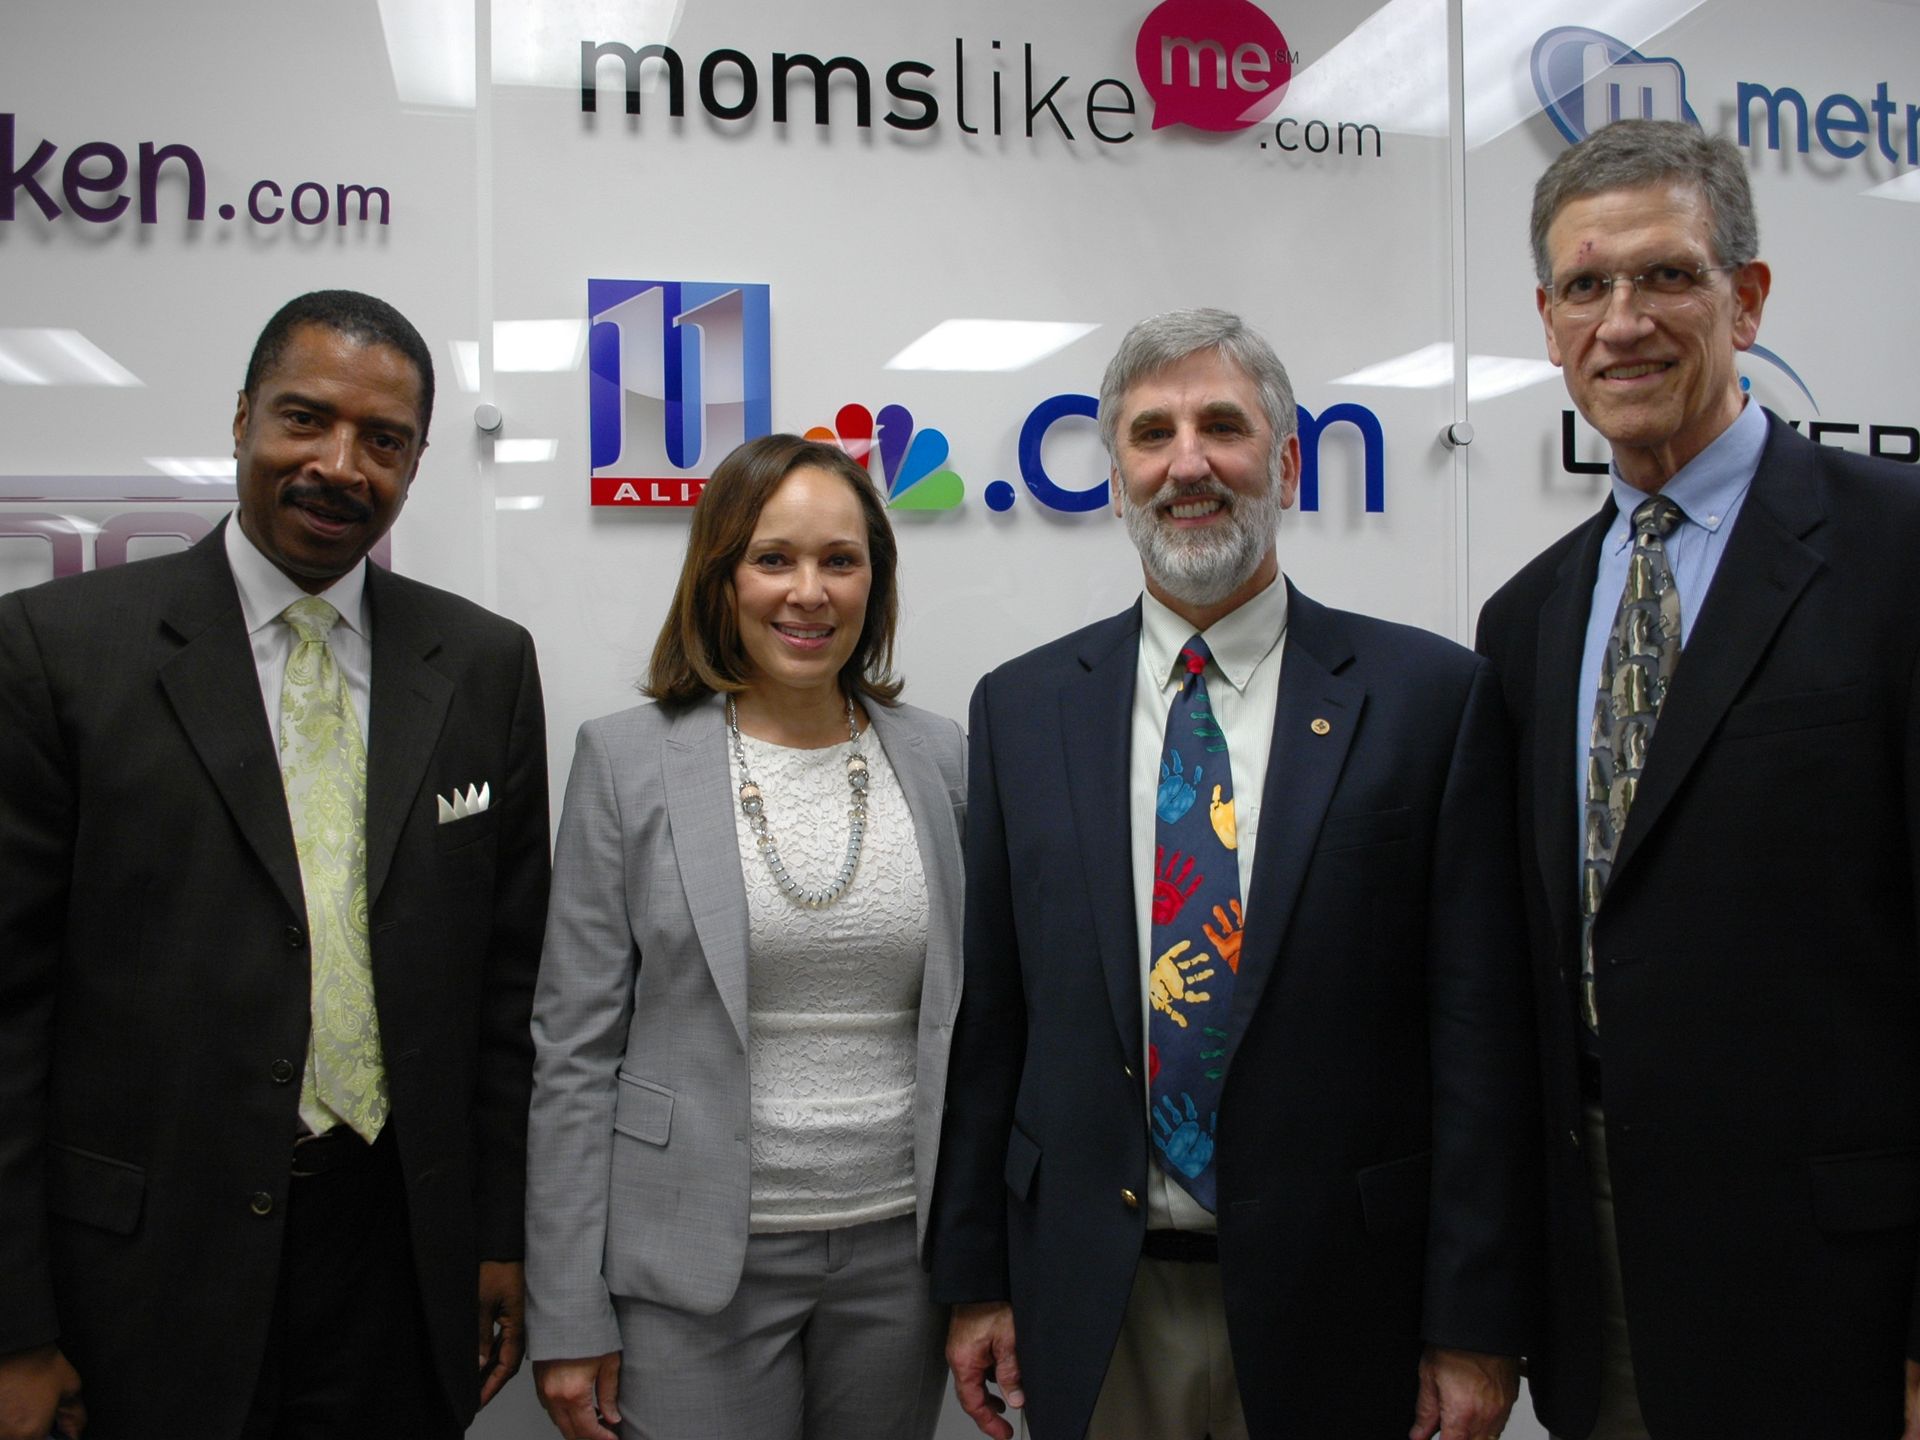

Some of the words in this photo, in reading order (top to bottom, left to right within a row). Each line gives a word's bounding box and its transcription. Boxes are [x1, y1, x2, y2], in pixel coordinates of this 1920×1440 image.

[1275, 49, 1299, 65] SM
[984, 393, 1385, 513] .cm
[613, 482, 706, 502] ALI
